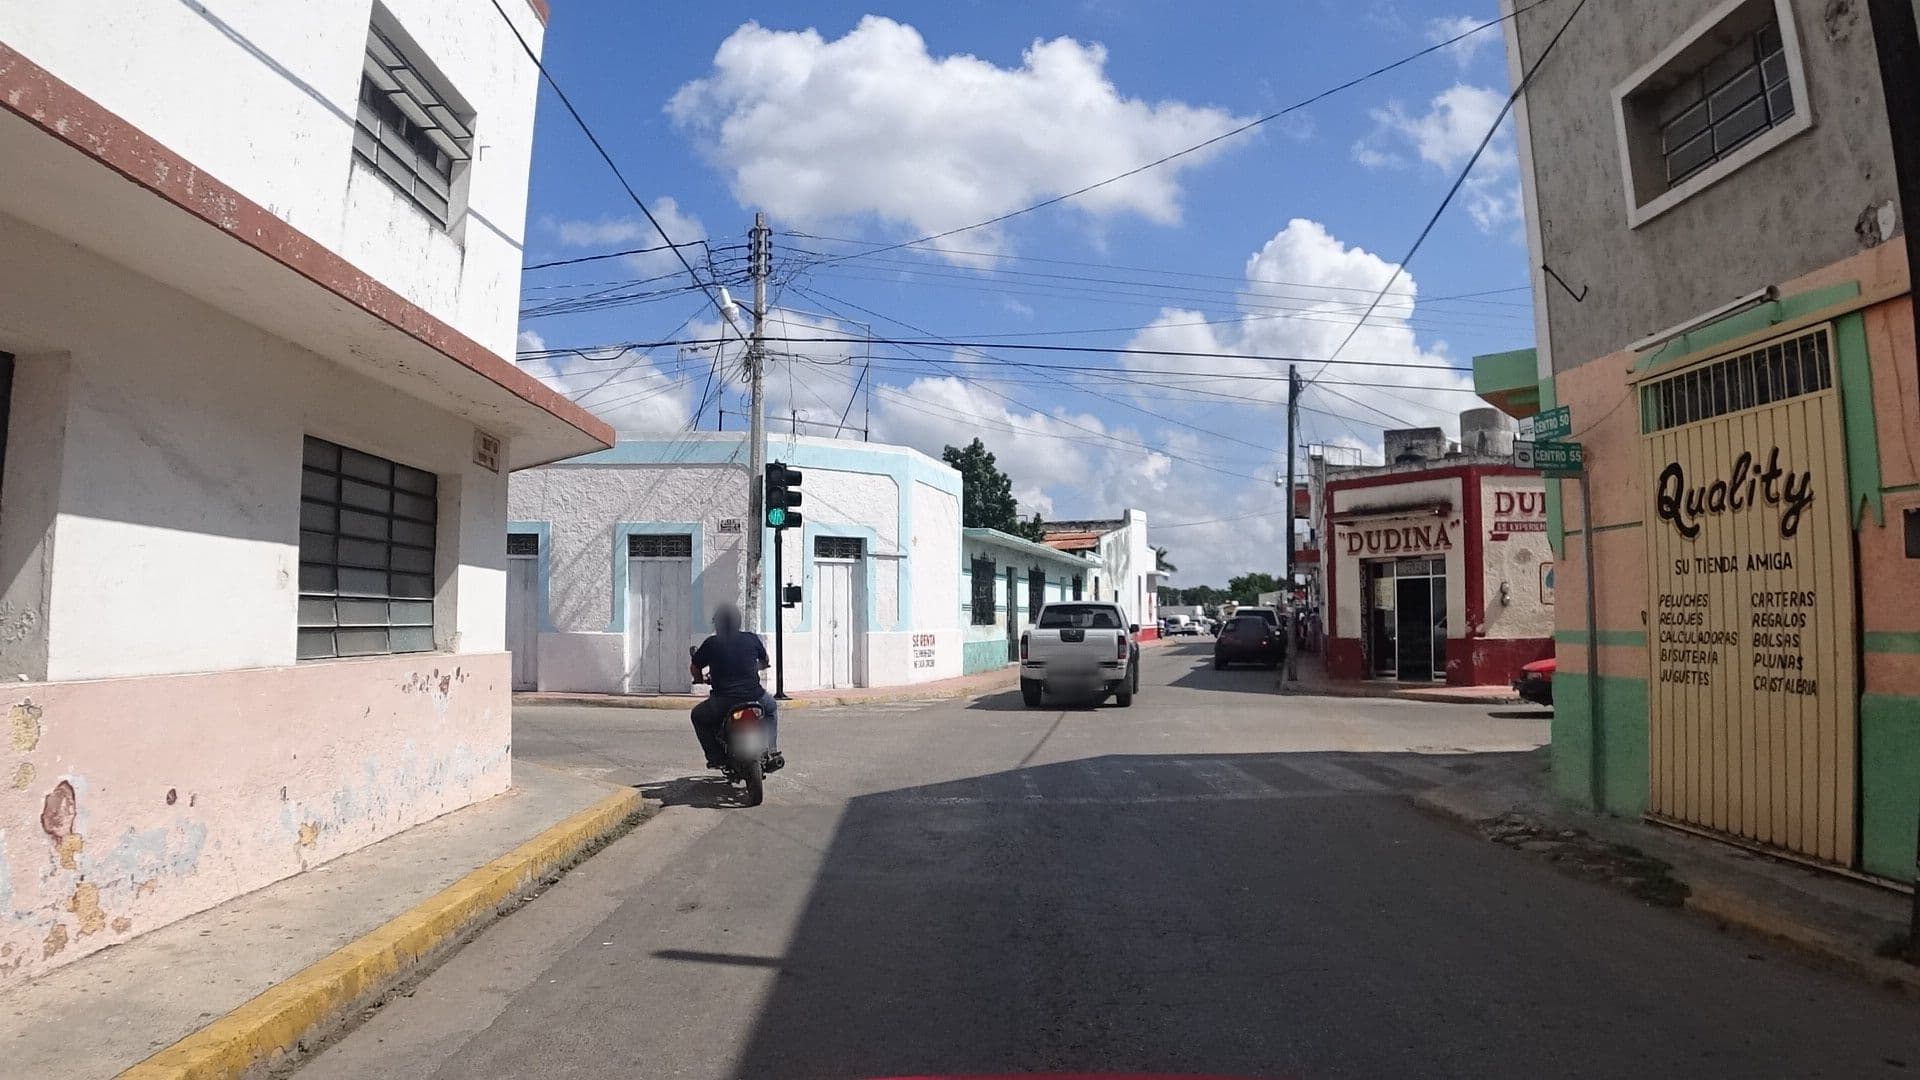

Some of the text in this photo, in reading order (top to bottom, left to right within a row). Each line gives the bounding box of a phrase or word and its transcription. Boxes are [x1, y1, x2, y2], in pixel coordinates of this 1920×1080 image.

[1535, 417, 1558, 434] CENTRO
[1535, 449, 1566, 462] CENTRO
[1569, 450, 1581, 462] 55
[1657, 446, 1815, 539] Quality
[1675, 552, 1792, 575] SU TIENDA AMIGA
[1659, 594, 1709, 607] PELUCHES
[1752, 592, 1816, 607] CARTERAS
[1660, 612, 1703, 626] RELOJES
[1753, 613, 1806, 628] REGALOS
[912, 634, 919, 648] SE
[1660, 632, 1738, 646] CALCULADORAS
[1753, 633, 1800, 648] BOLSAS
[1661, 650, 1718, 664] BISUTERIA
[1660, 670, 1709, 686] JUGUETES
